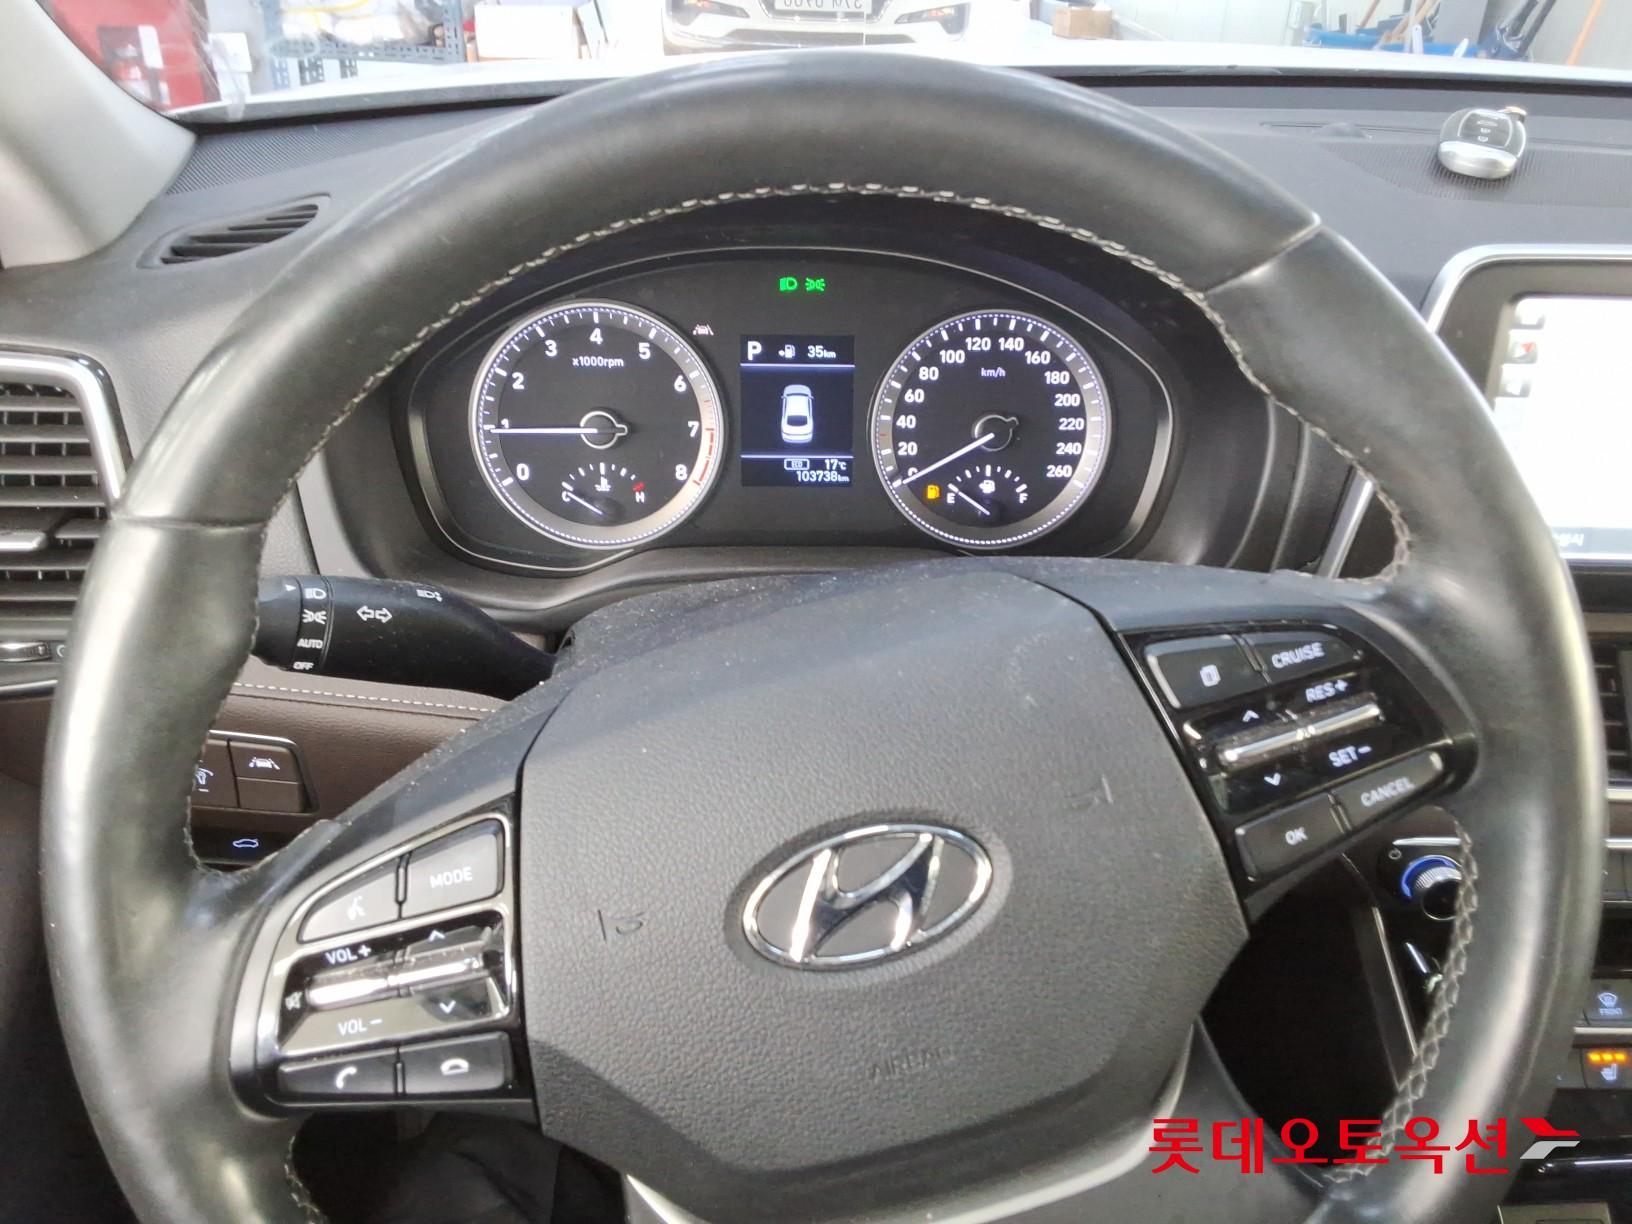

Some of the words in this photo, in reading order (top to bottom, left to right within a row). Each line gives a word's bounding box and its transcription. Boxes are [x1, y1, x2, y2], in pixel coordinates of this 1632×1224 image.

[589, 328, 604, 345] 4
[545, 340, 558, 357] 3
[638, 342, 651, 359] 5
[747, 340, 763, 361] P
[965, 337, 992, 351] 120
[998, 337, 1025, 351] 140
[572, 356, 624, 369] x1000rpm
[939, 350, 966, 364] 100
[1025, 351, 1051, 365] 160
[918, 367, 940, 381] 80
[980, 367, 1006, 378] km/h
[1044, 371, 1070, 386] 180
[512, 372, 525, 390] 2
[673, 375, 686, 392] 6
[904, 389, 925, 403] 60
[1054, 393, 1081, 407] 200
[896, 415, 917, 429] 40
[1059, 417, 1085, 431] 220
[688, 421, 699, 438] 7
[898, 442, 918, 456] 20
[1056, 443, 1082, 457] 240
[516, 464, 530, 481] 0
[675, 464, 688, 482] 8
[796, 470, 850, 482] 103738km
[1046, 464, 1072, 479] 260
[635, 491, 645, 503] H
[946, 492, 956, 504] E
[1019, 493, 1028, 504] F
[297, 638, 323, 649] AUTO
[1271, 642, 1324, 668] CRUISE
[293, 662, 314, 670] OFF
[1306, 679, 1349, 703] RES+
[1361, 777, 1414, 807] CANCEL
[1285, 826, 1308, 846] OK
[430, 867, 473, 889] MODE
